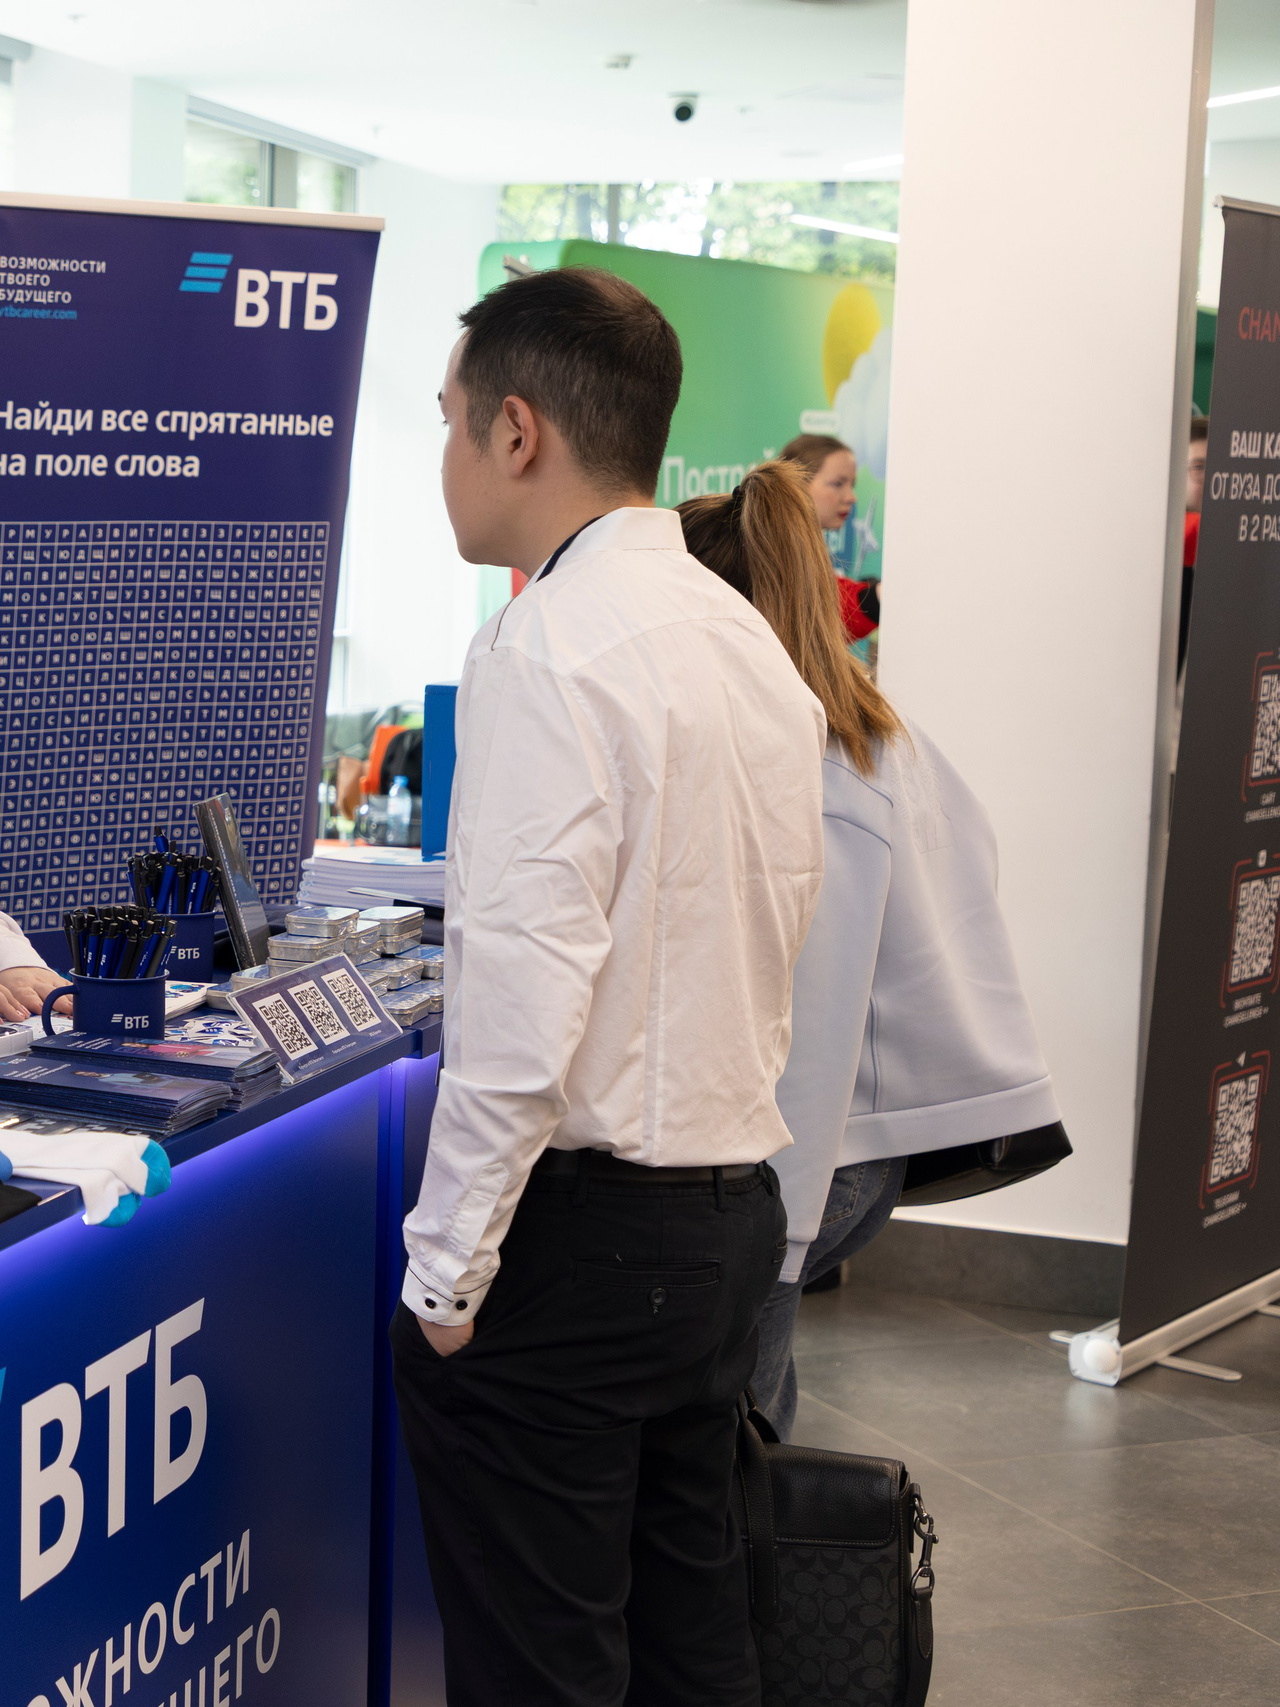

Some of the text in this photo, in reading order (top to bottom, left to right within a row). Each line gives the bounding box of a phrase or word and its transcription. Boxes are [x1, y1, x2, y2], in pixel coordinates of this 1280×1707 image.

[234, 268, 339, 331] ВТБ
[101, 409, 148, 432] все
[155, 411, 335, 441] спрятанные
[1230, 430, 1262, 458] ВАШ
[35, 453, 108, 477] поле
[114, 455, 200, 477] слова
[1211, 471, 1229, 500] ОТ
[1231, 472, 1261, 501] ВУЗА
[1239, 514, 1248, 542] В
[1250, 514, 1260, 542] 2
[177, 948, 200, 960] ВТБ
[124, 1015, 150, 1029] ВТБ
[21, 1297, 208, 1602] ВТБ
[27, 1529, 250, 1707] ЖНОСТИ
